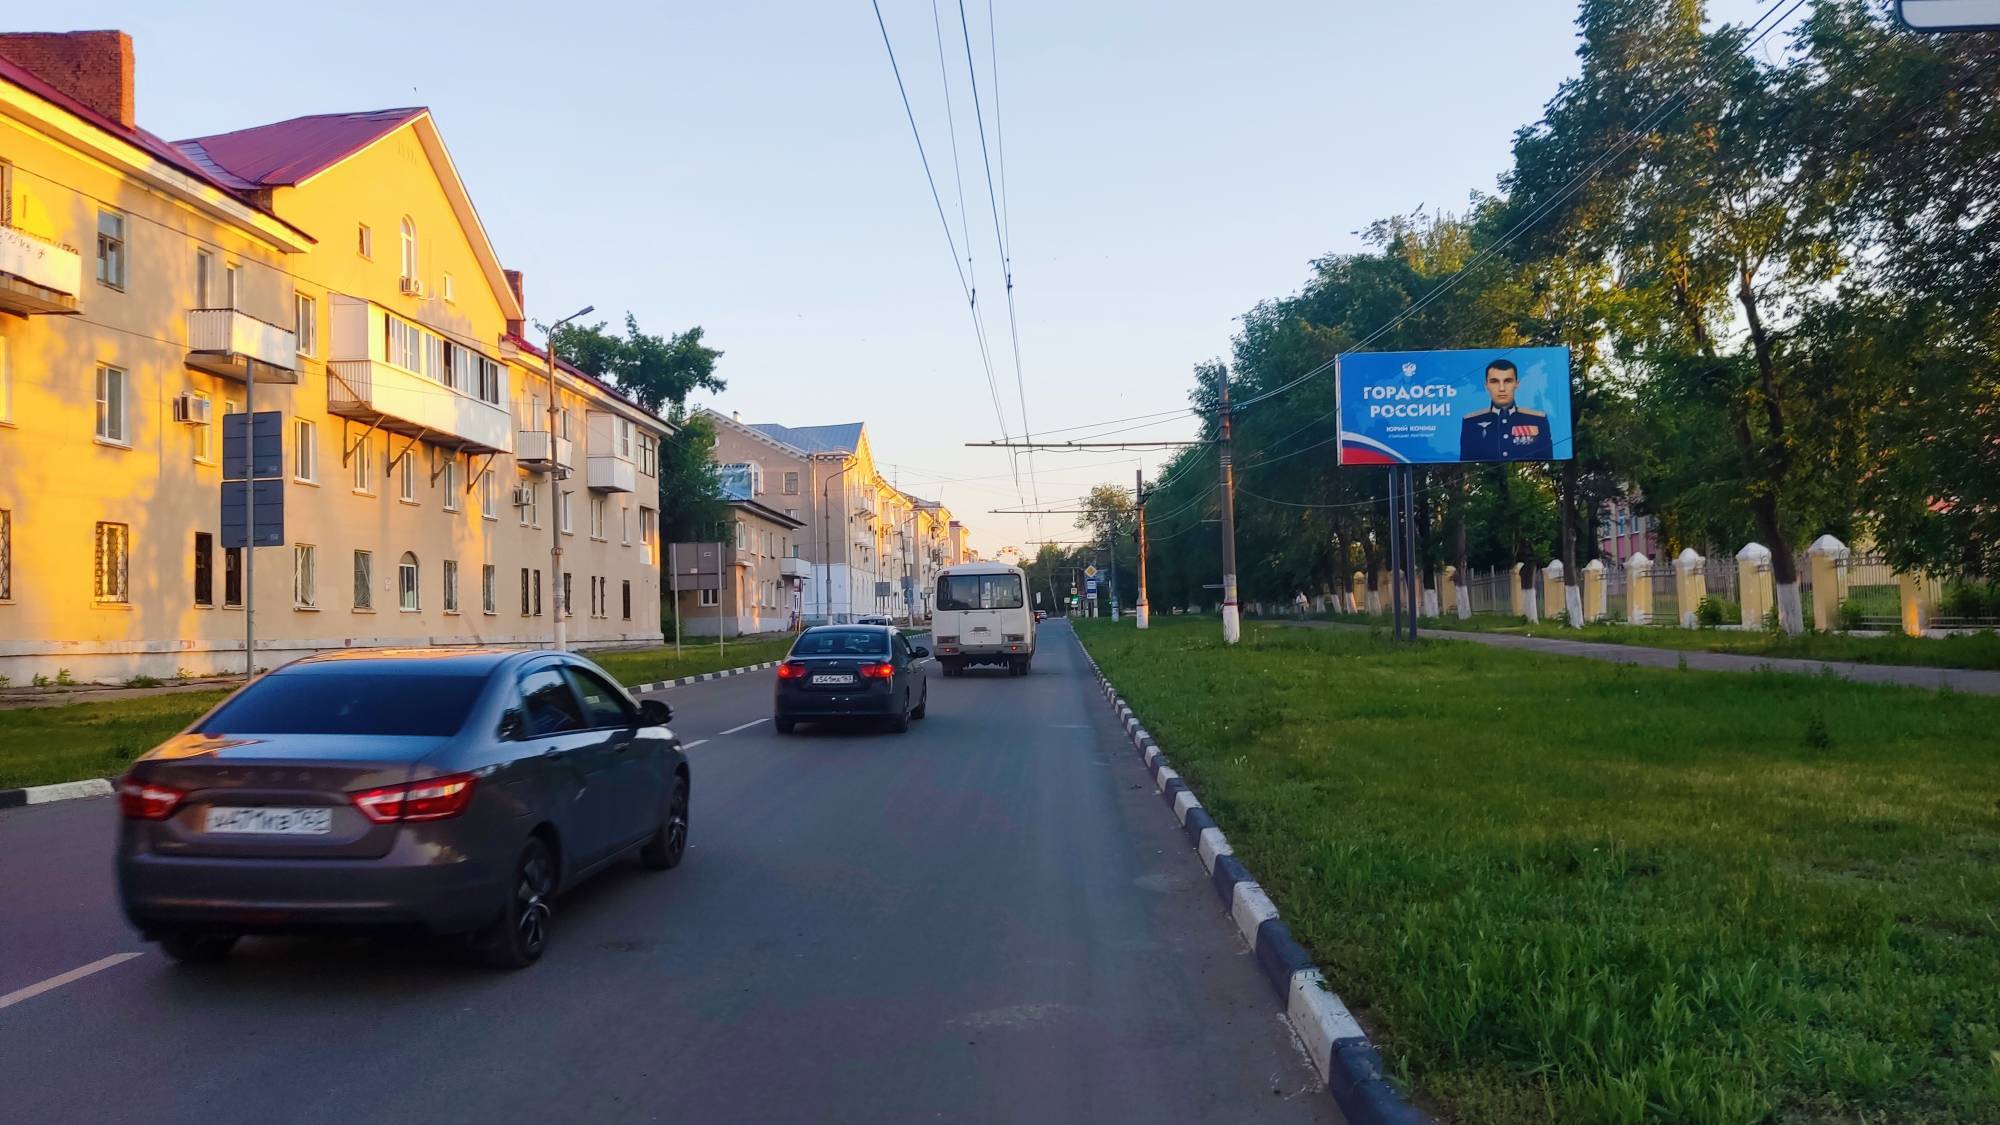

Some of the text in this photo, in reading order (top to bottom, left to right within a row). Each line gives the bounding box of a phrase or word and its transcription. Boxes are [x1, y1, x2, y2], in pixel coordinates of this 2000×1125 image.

[1363, 384, 1457, 400] ГОРДОСТЬ
[1370, 403, 1450, 418] РОССИИ!
[1386, 424, 1408, 432] ЮРИЙ
